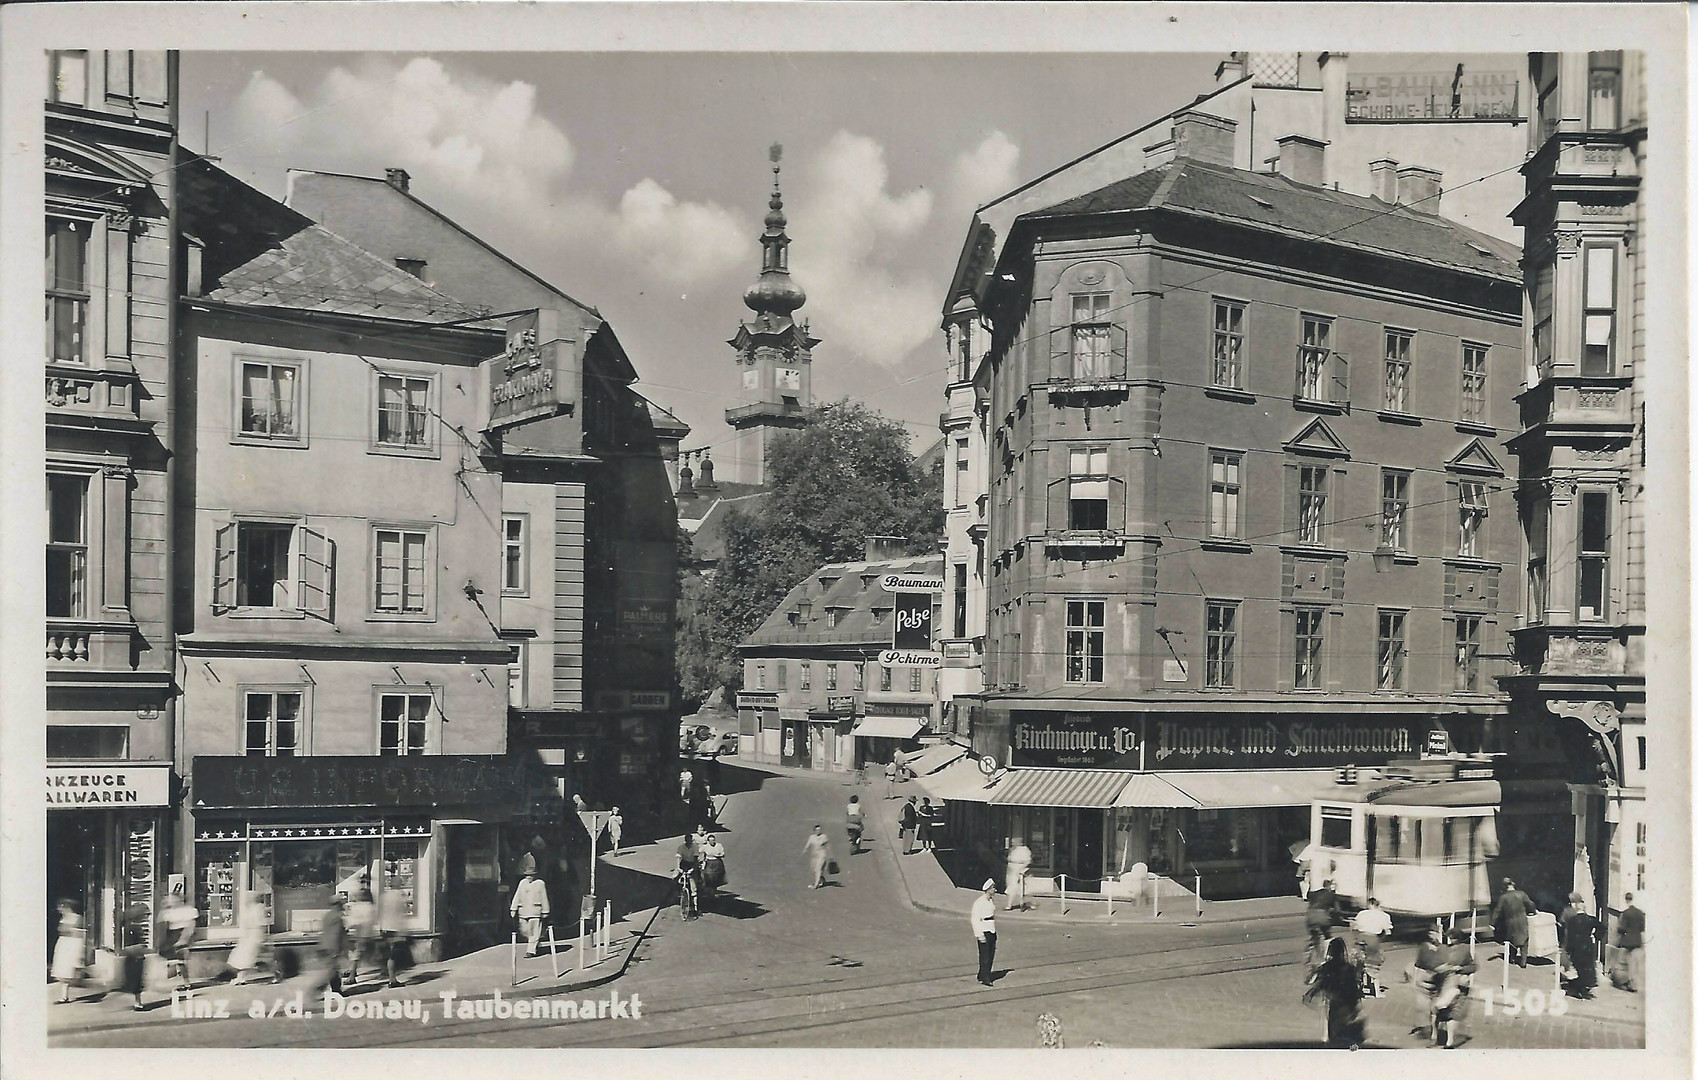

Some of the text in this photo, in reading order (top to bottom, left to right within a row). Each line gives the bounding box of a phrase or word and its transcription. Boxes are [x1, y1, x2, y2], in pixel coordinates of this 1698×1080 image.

[1376, 75, 1508, 98] BAUMNN
[884, 576, 943, 588] Baumann
[896, 608, 930, 632] Pelze
[884, 652, 940, 665] Schirme
[1015, 723, 1140, 754] Kirchmayr u. Co.
[1240, 720, 1277, 753] und
[46, 791, 137, 803] ALLWAREN
